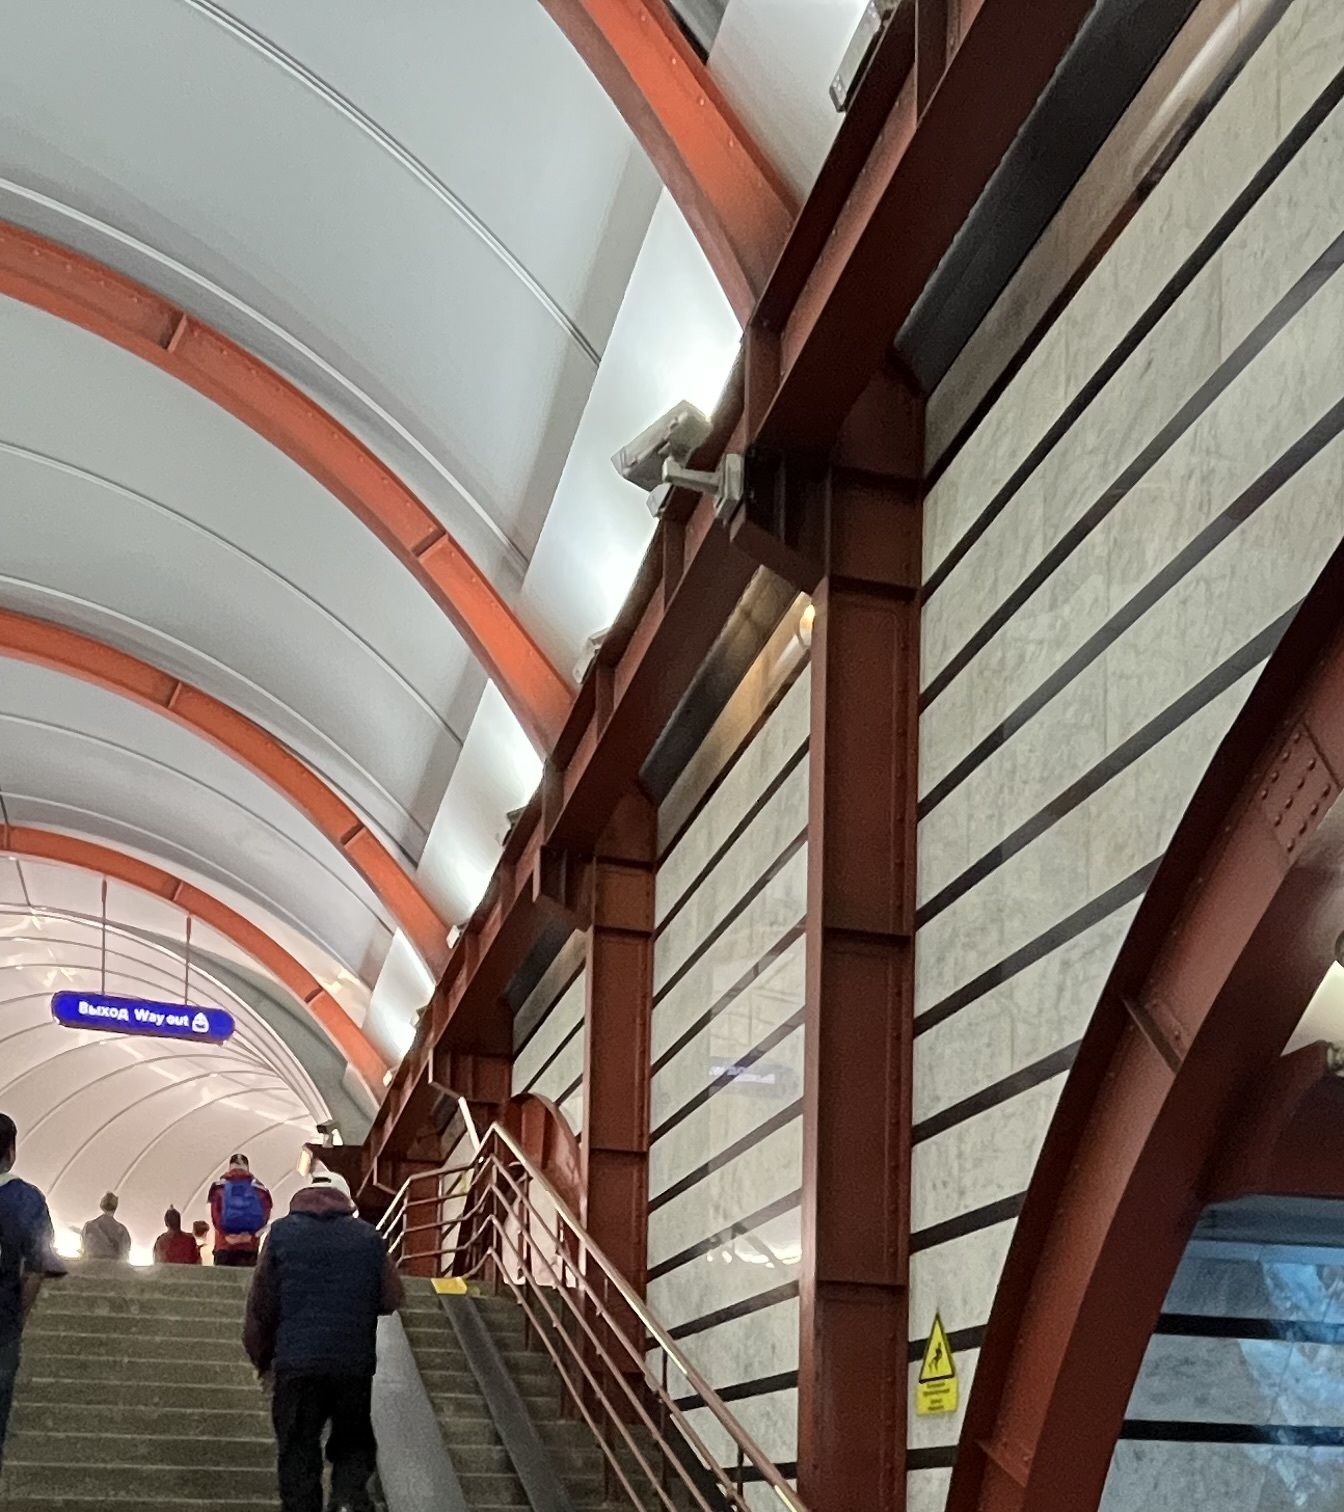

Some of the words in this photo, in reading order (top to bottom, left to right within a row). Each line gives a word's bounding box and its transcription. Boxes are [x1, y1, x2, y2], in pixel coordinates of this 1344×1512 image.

[78, 1000, 130, 1022] Выход
[133, 1007, 165, 1027] Way
[165, 1013, 190, 1028] out
